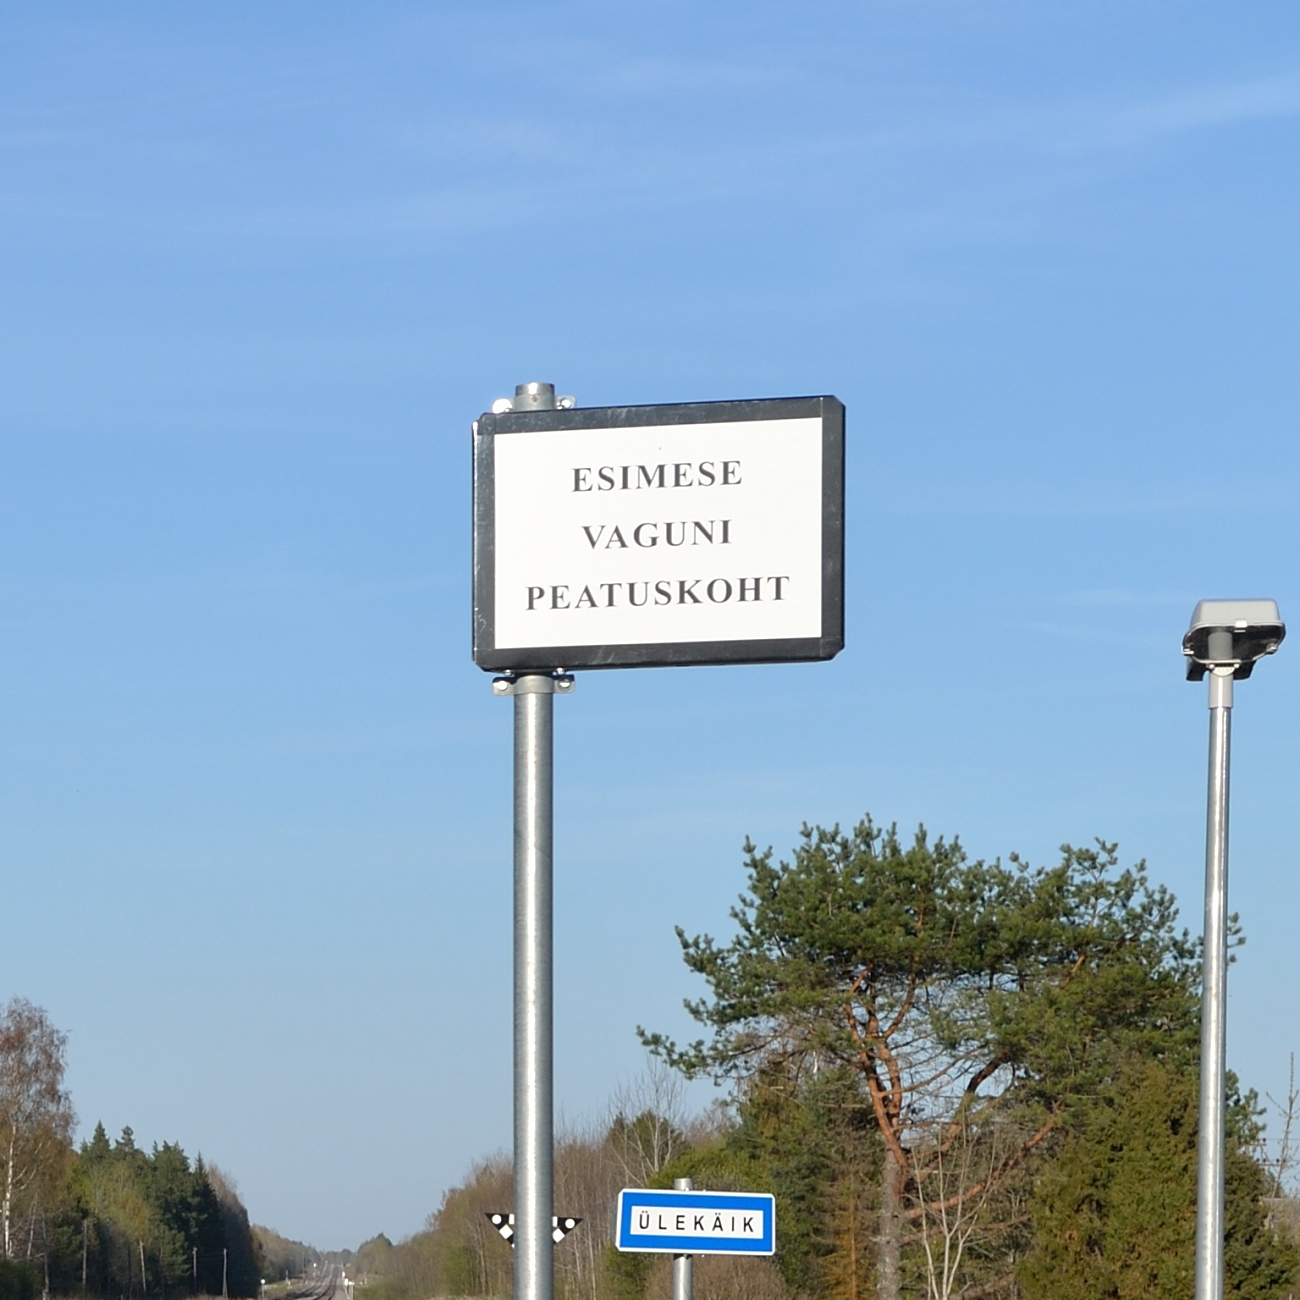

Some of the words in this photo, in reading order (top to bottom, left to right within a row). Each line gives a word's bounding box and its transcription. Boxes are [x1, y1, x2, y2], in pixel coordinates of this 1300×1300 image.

[573, 460, 743, 493] ESIMESE
[582, 519, 732, 549] VAGUNI
[525, 575, 791, 611] PEATUSKOHT
[638, 1210, 755, 1233] ÜLEKÄIK
